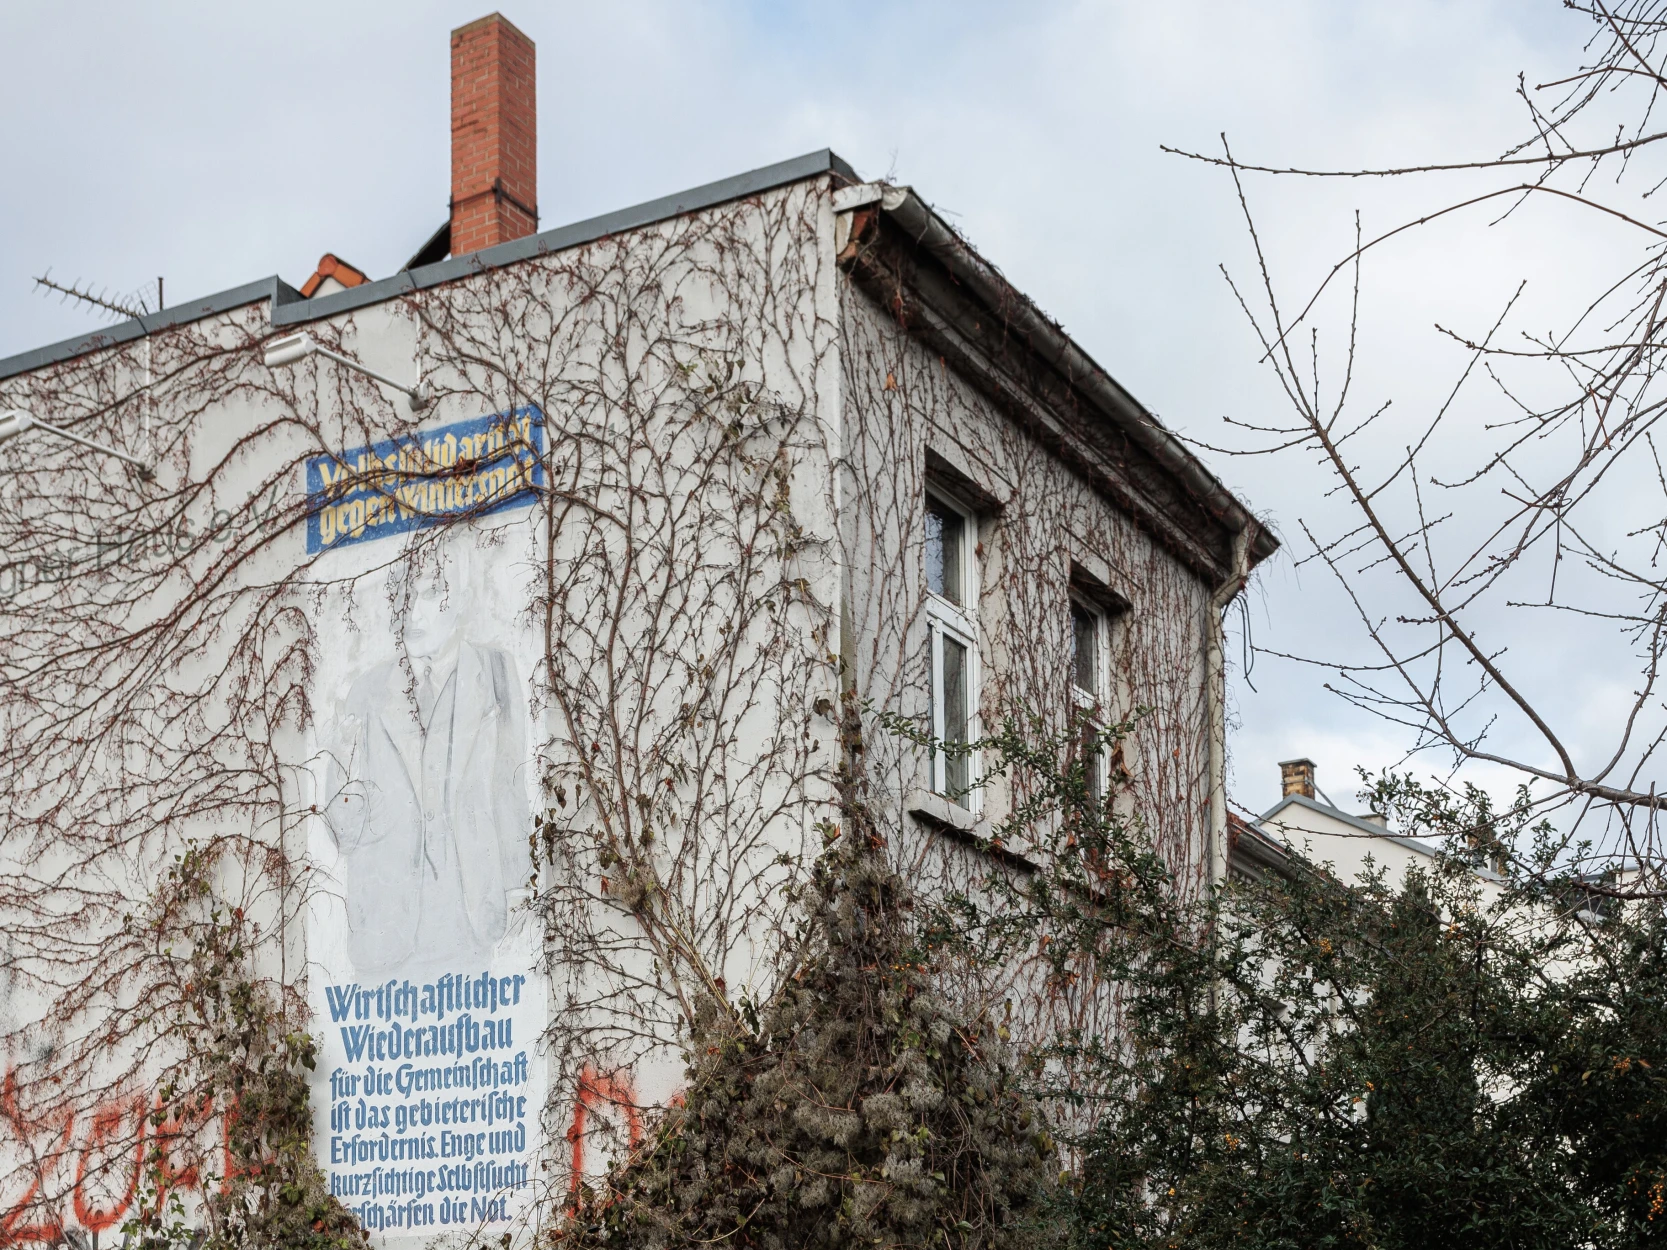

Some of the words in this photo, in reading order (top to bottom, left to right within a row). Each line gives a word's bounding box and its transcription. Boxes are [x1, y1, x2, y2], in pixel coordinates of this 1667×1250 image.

[96, 518, 195, 570] Haus
[318, 493, 398, 545] gegen
[325, 971, 526, 1024] Wirtschaftlicher
[340, 1013, 513, 1064] Wiederaufbau
[329, 1067, 361, 1101] für
[363, 1065, 393, 1097] die
[395, 1051, 528, 1099] Gemeinschaft
[331, 1101, 351, 1133] ist
[355, 1098, 391, 1130] das
[395, 1090, 527, 1134] gebieterische
[331, 1132, 439, 1166] Erfordernis.
[441, 1130, 486, 1162] Enge
[489, 1121, 526, 1153] und
[330, 1166, 436, 1199] kurzsichtige
[436, 1159, 529, 1195] Selbstsucht
[439, 1196, 468, 1224] die
[470, 1195, 513, 1223] Not.
